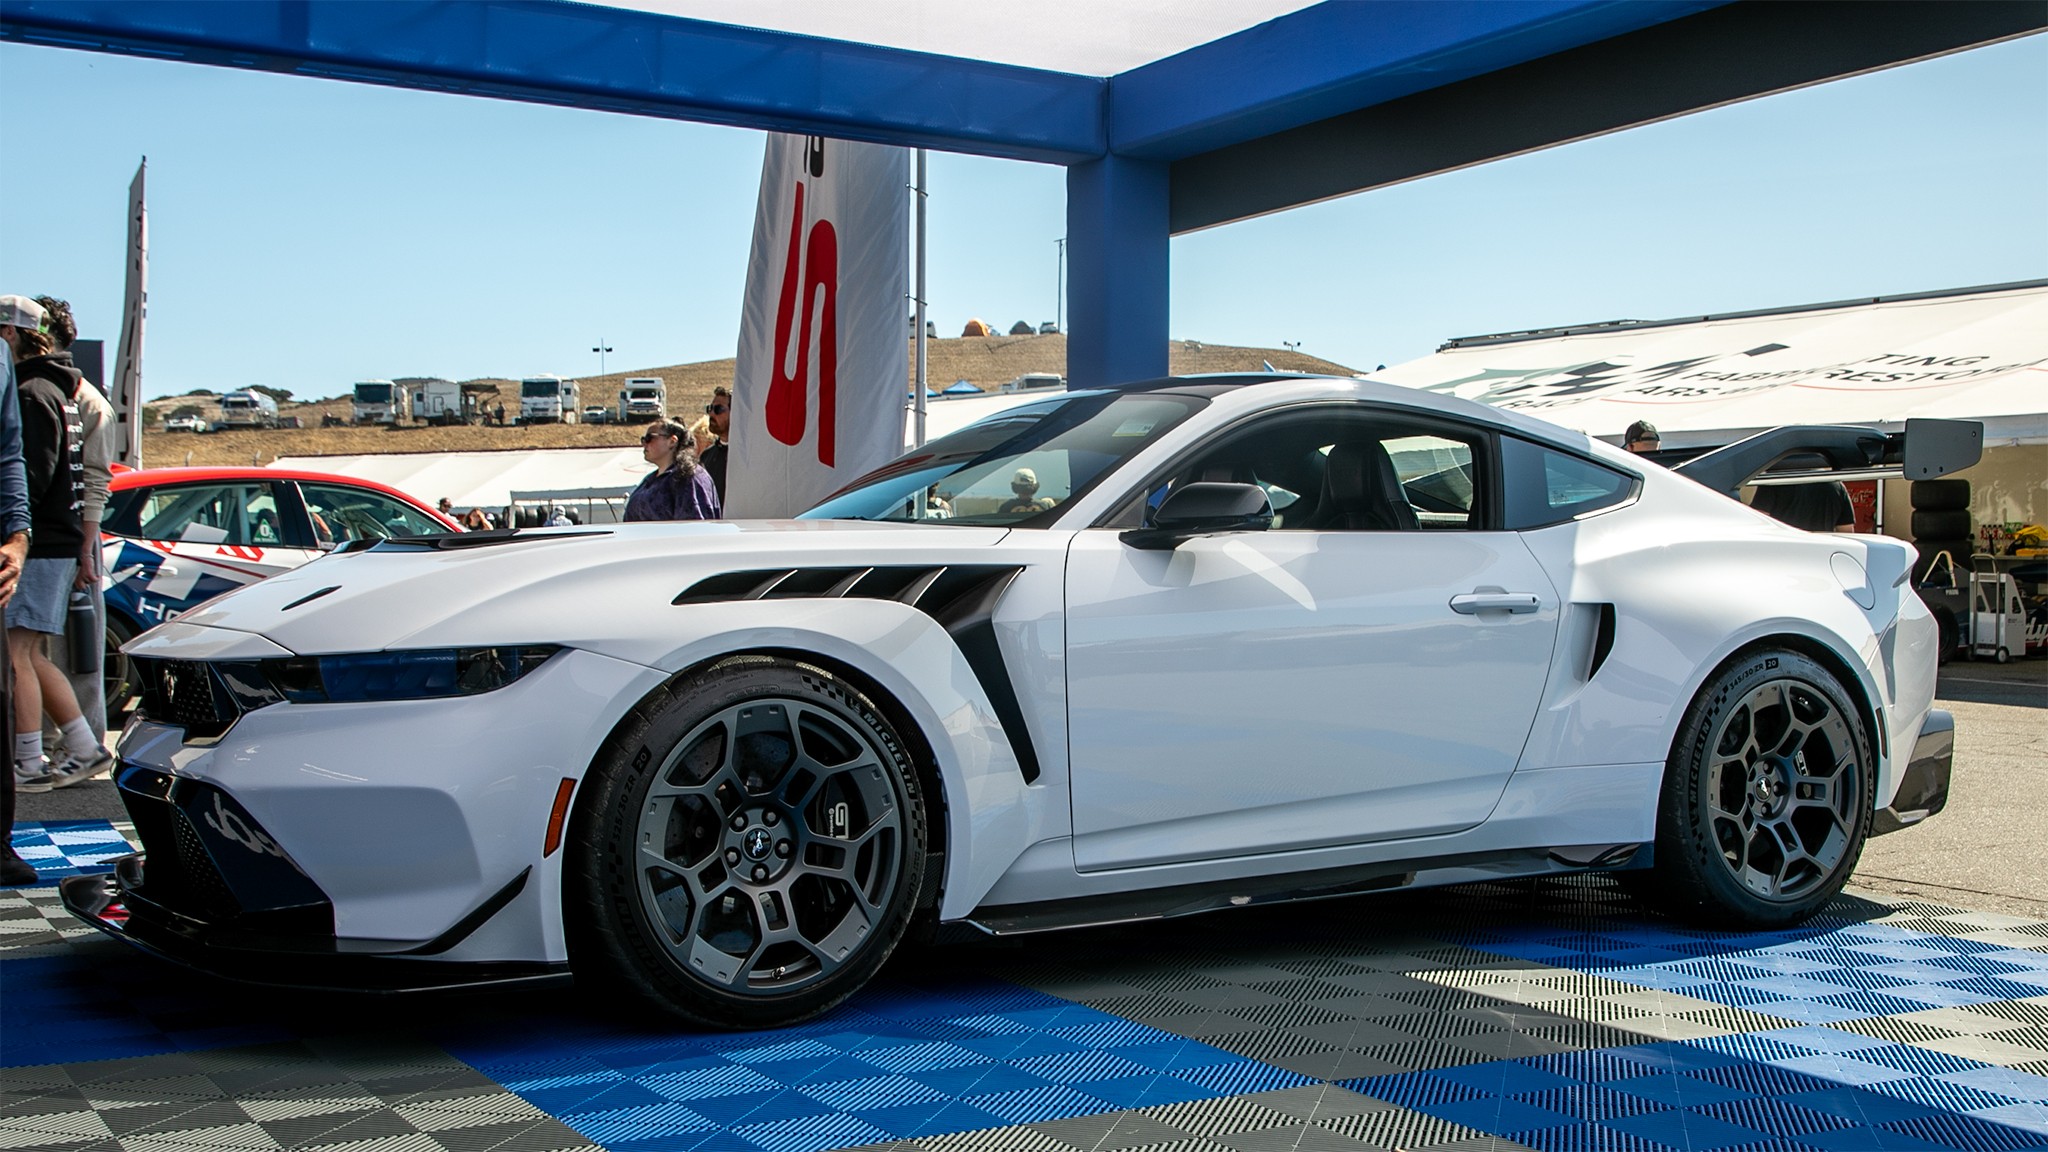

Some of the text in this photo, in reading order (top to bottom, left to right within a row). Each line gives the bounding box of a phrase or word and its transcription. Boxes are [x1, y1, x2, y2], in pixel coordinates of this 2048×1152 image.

[1730, 667, 1755, 690] 345/30
[1754, 663, 1764, 673] ZR
[864, 712, 916, 795] MICHELIN
[1689, 722, 1711, 804] MICHELIN
[612, 752, 648, 842] 325/30 ZR 20
